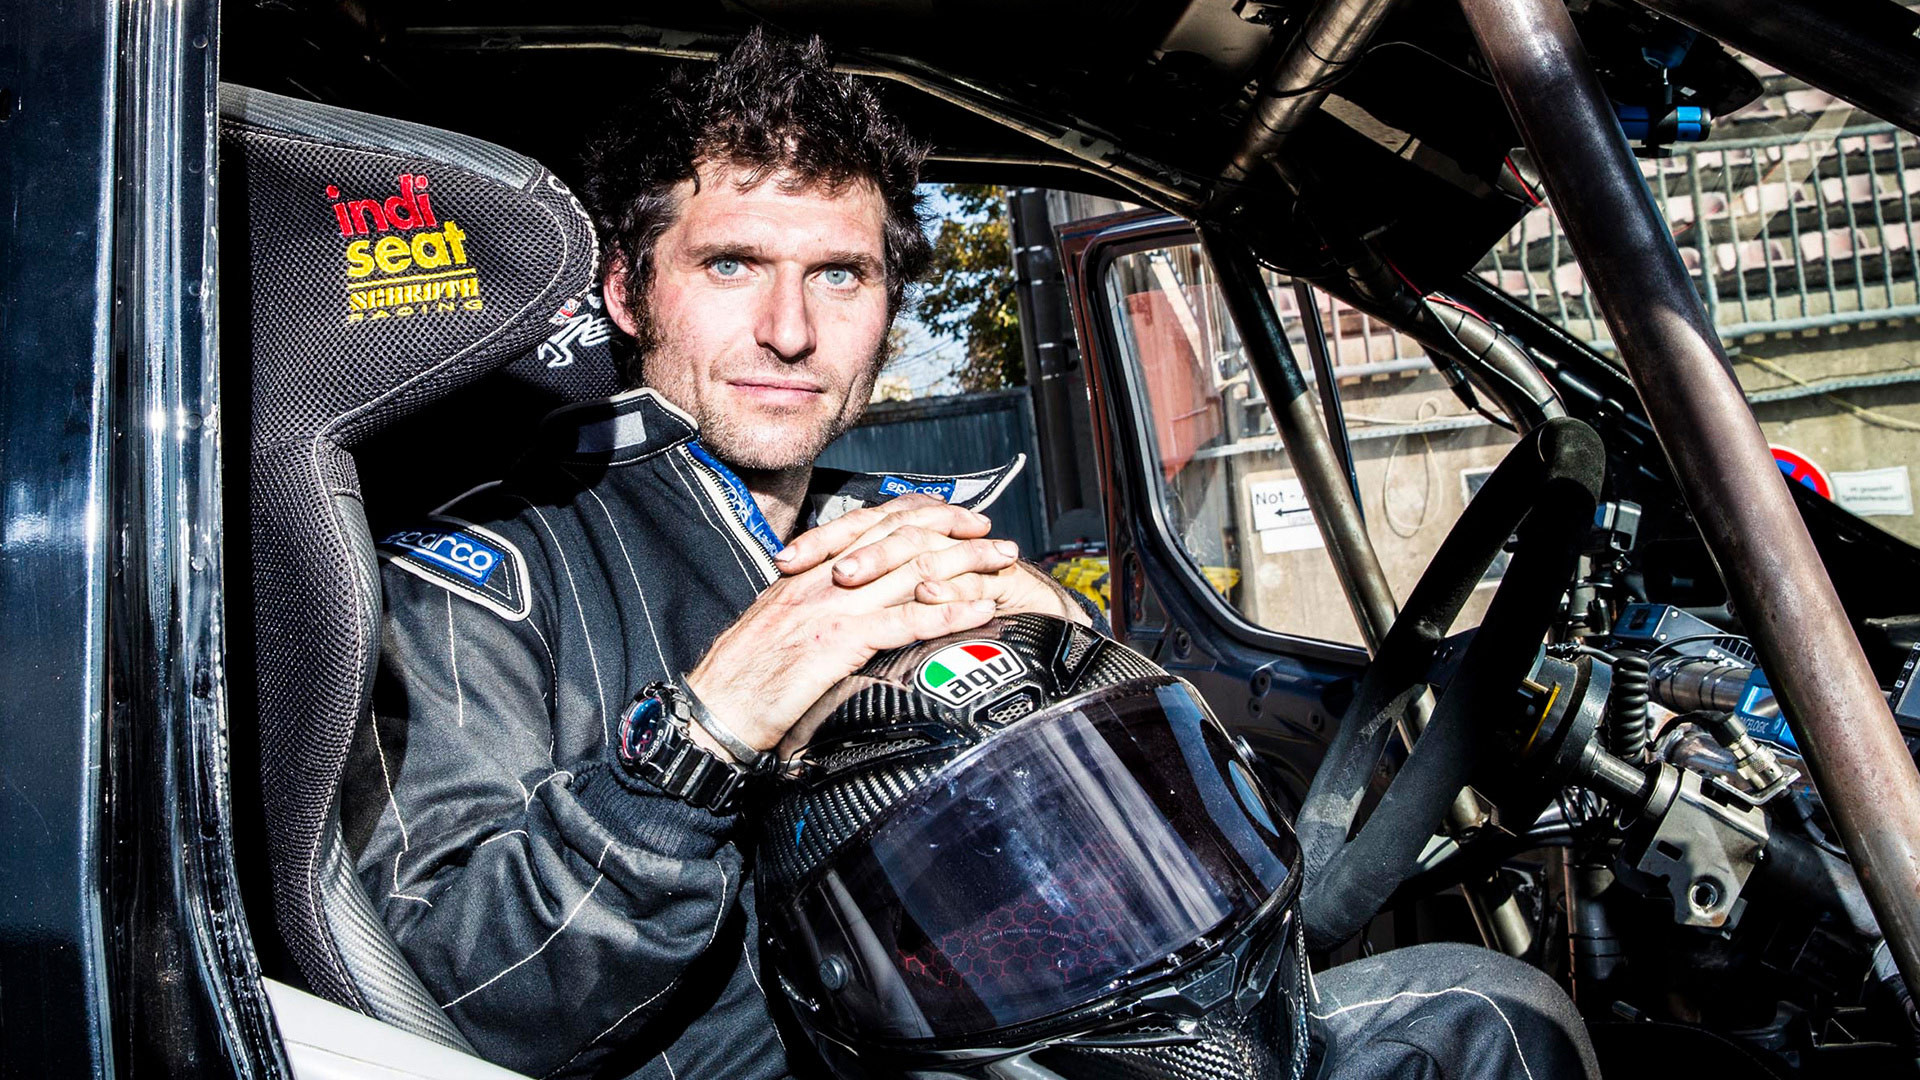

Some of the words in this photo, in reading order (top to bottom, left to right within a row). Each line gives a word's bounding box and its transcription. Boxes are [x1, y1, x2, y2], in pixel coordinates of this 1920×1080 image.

[326, 173, 438, 237] indi
[346, 221, 467, 278] seat
[348, 299, 483, 323] RACING
[349, 277, 480, 311] SCHROTH
[1256, 491, 1284, 505] Not
[946, 656, 1013, 699] agv
